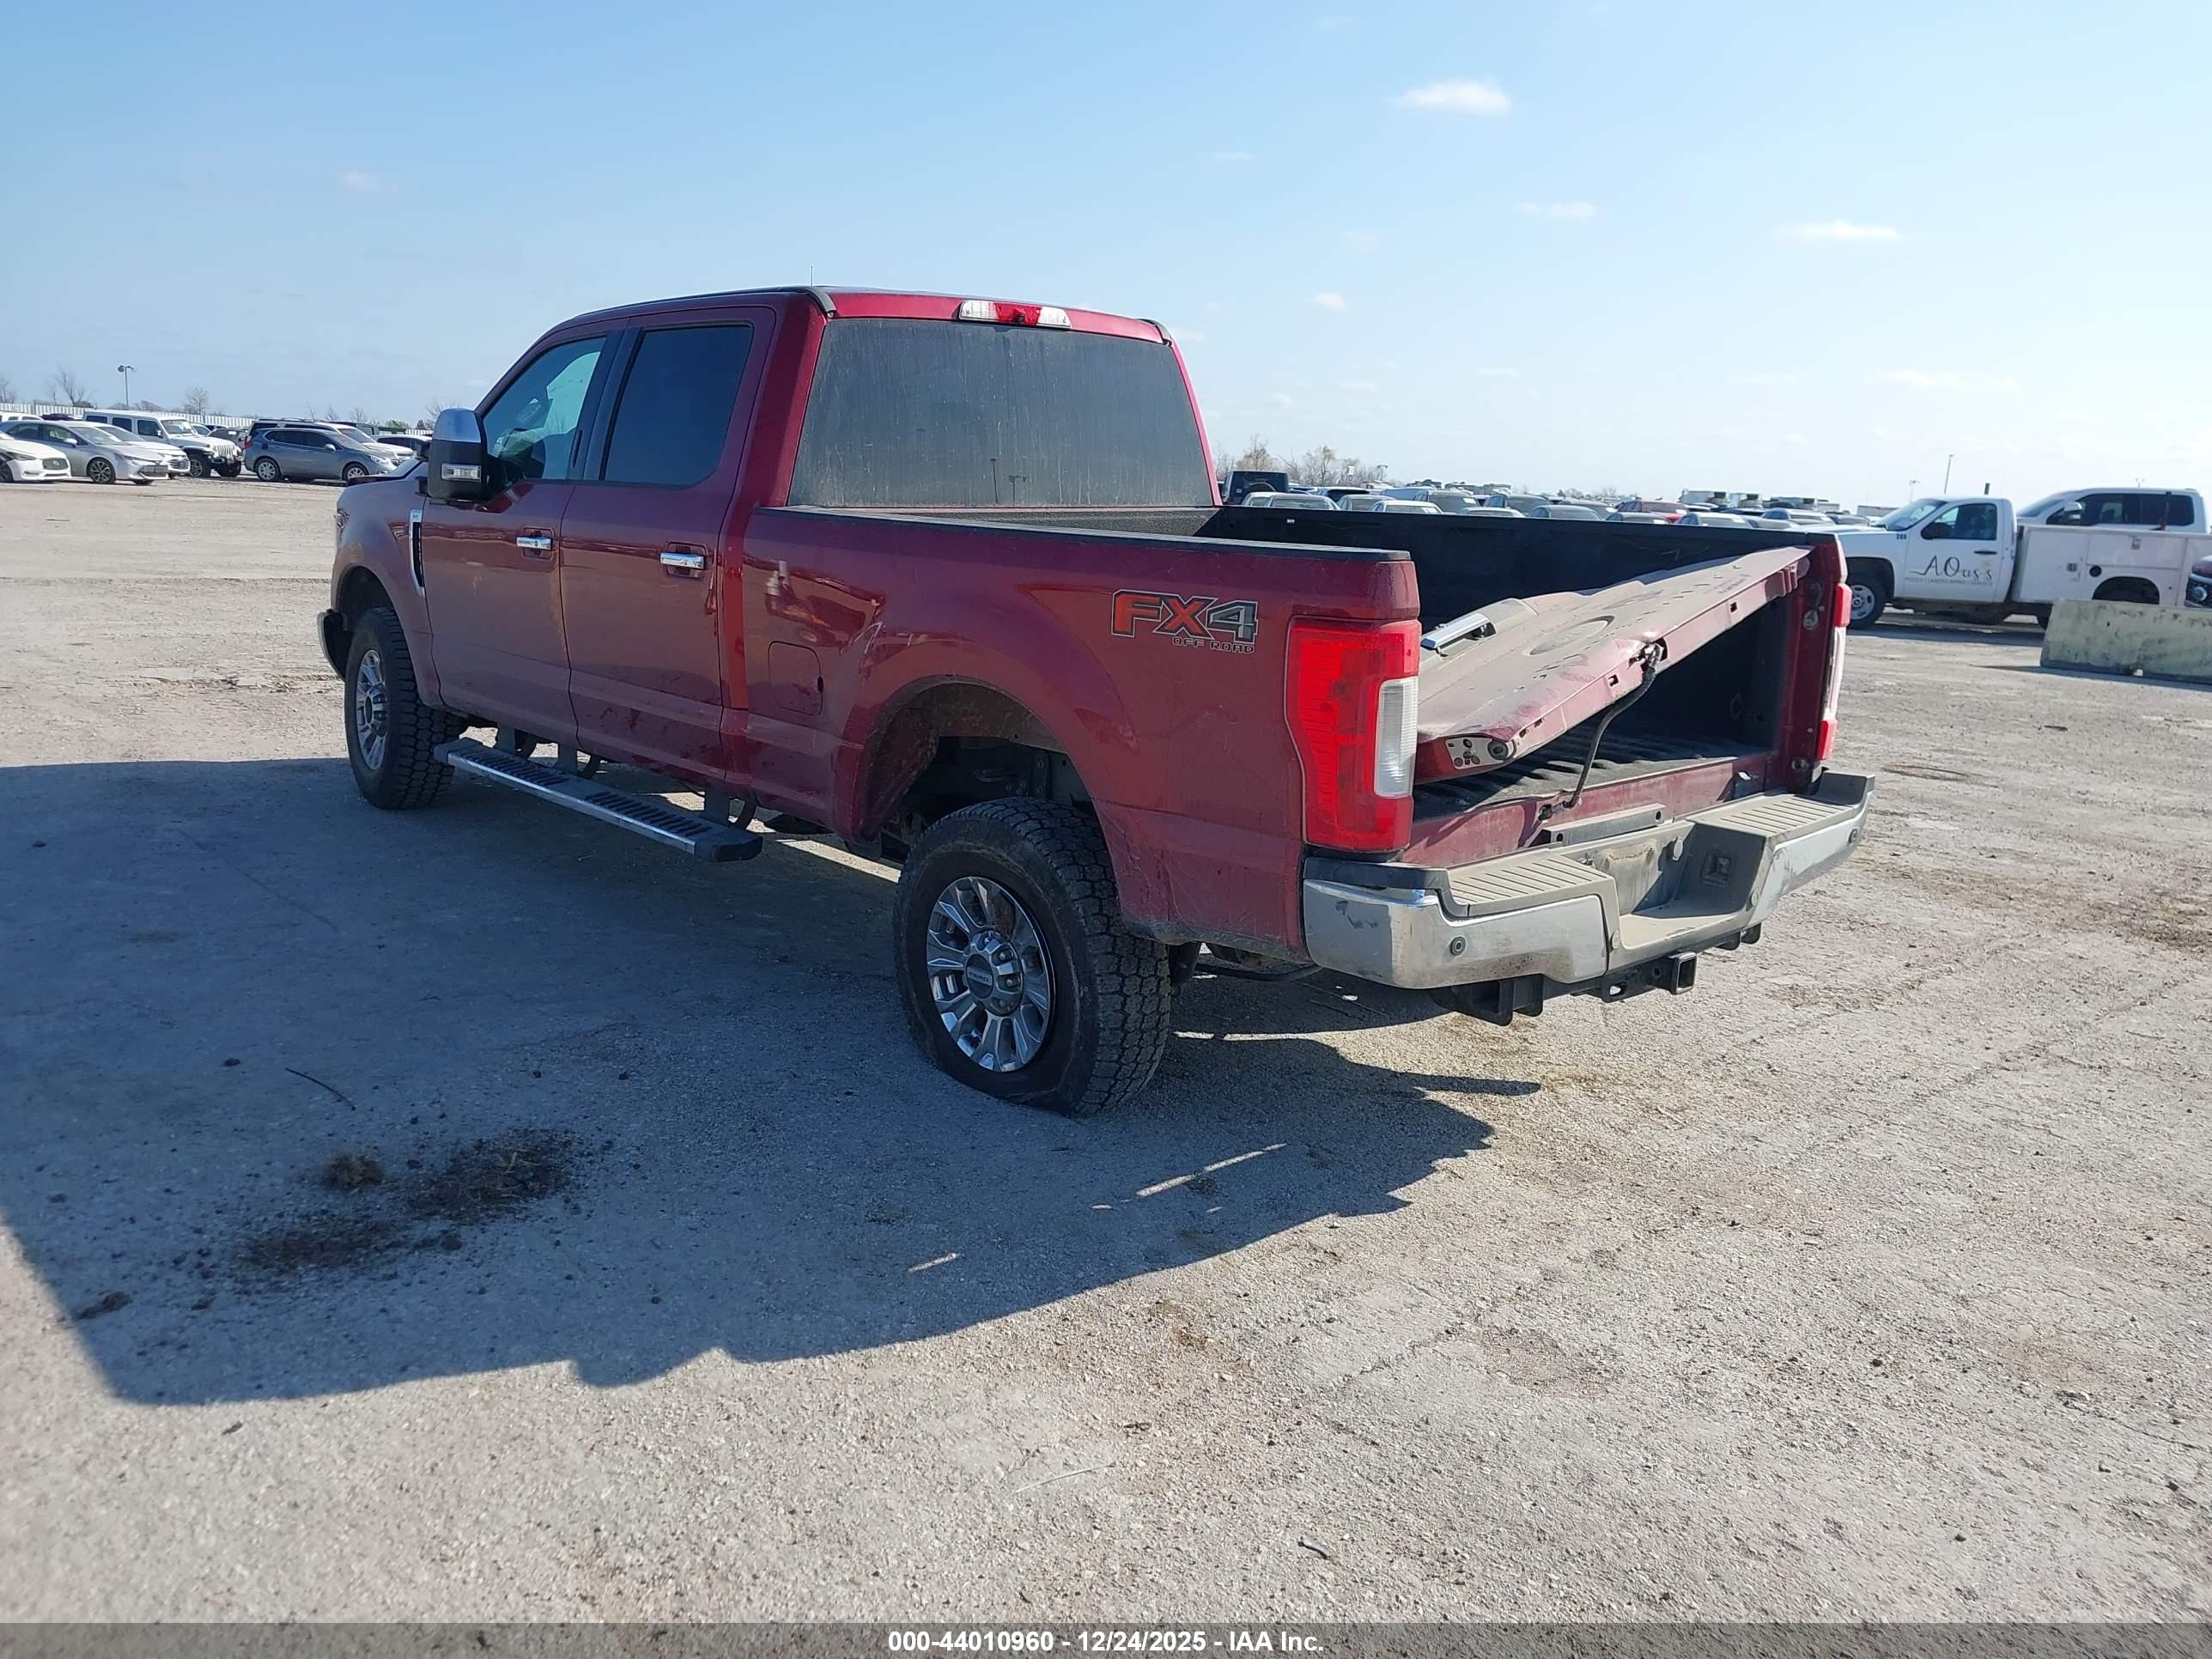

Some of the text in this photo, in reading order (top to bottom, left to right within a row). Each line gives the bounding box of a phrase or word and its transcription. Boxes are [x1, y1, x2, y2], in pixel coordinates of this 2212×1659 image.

[1111, 589, 1258, 644] FX4
[1172, 636, 1255, 653] OFF ROAD
